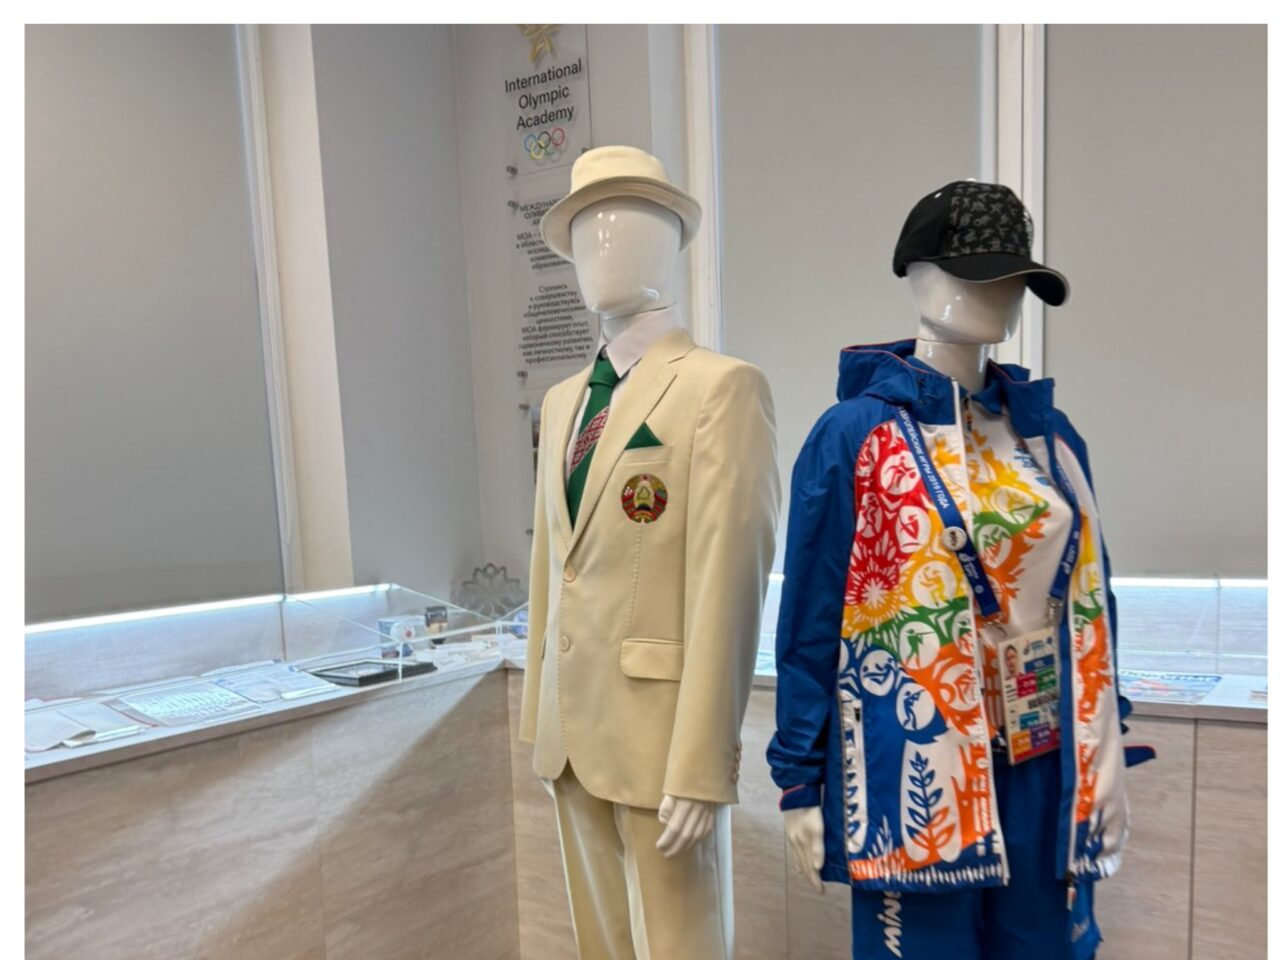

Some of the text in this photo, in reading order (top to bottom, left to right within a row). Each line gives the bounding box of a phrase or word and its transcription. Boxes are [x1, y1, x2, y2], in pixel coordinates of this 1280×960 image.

[505, 59, 582, 93] International
[518, 86, 570, 110] Olympic
[516, 106, 574, 130] Academy
